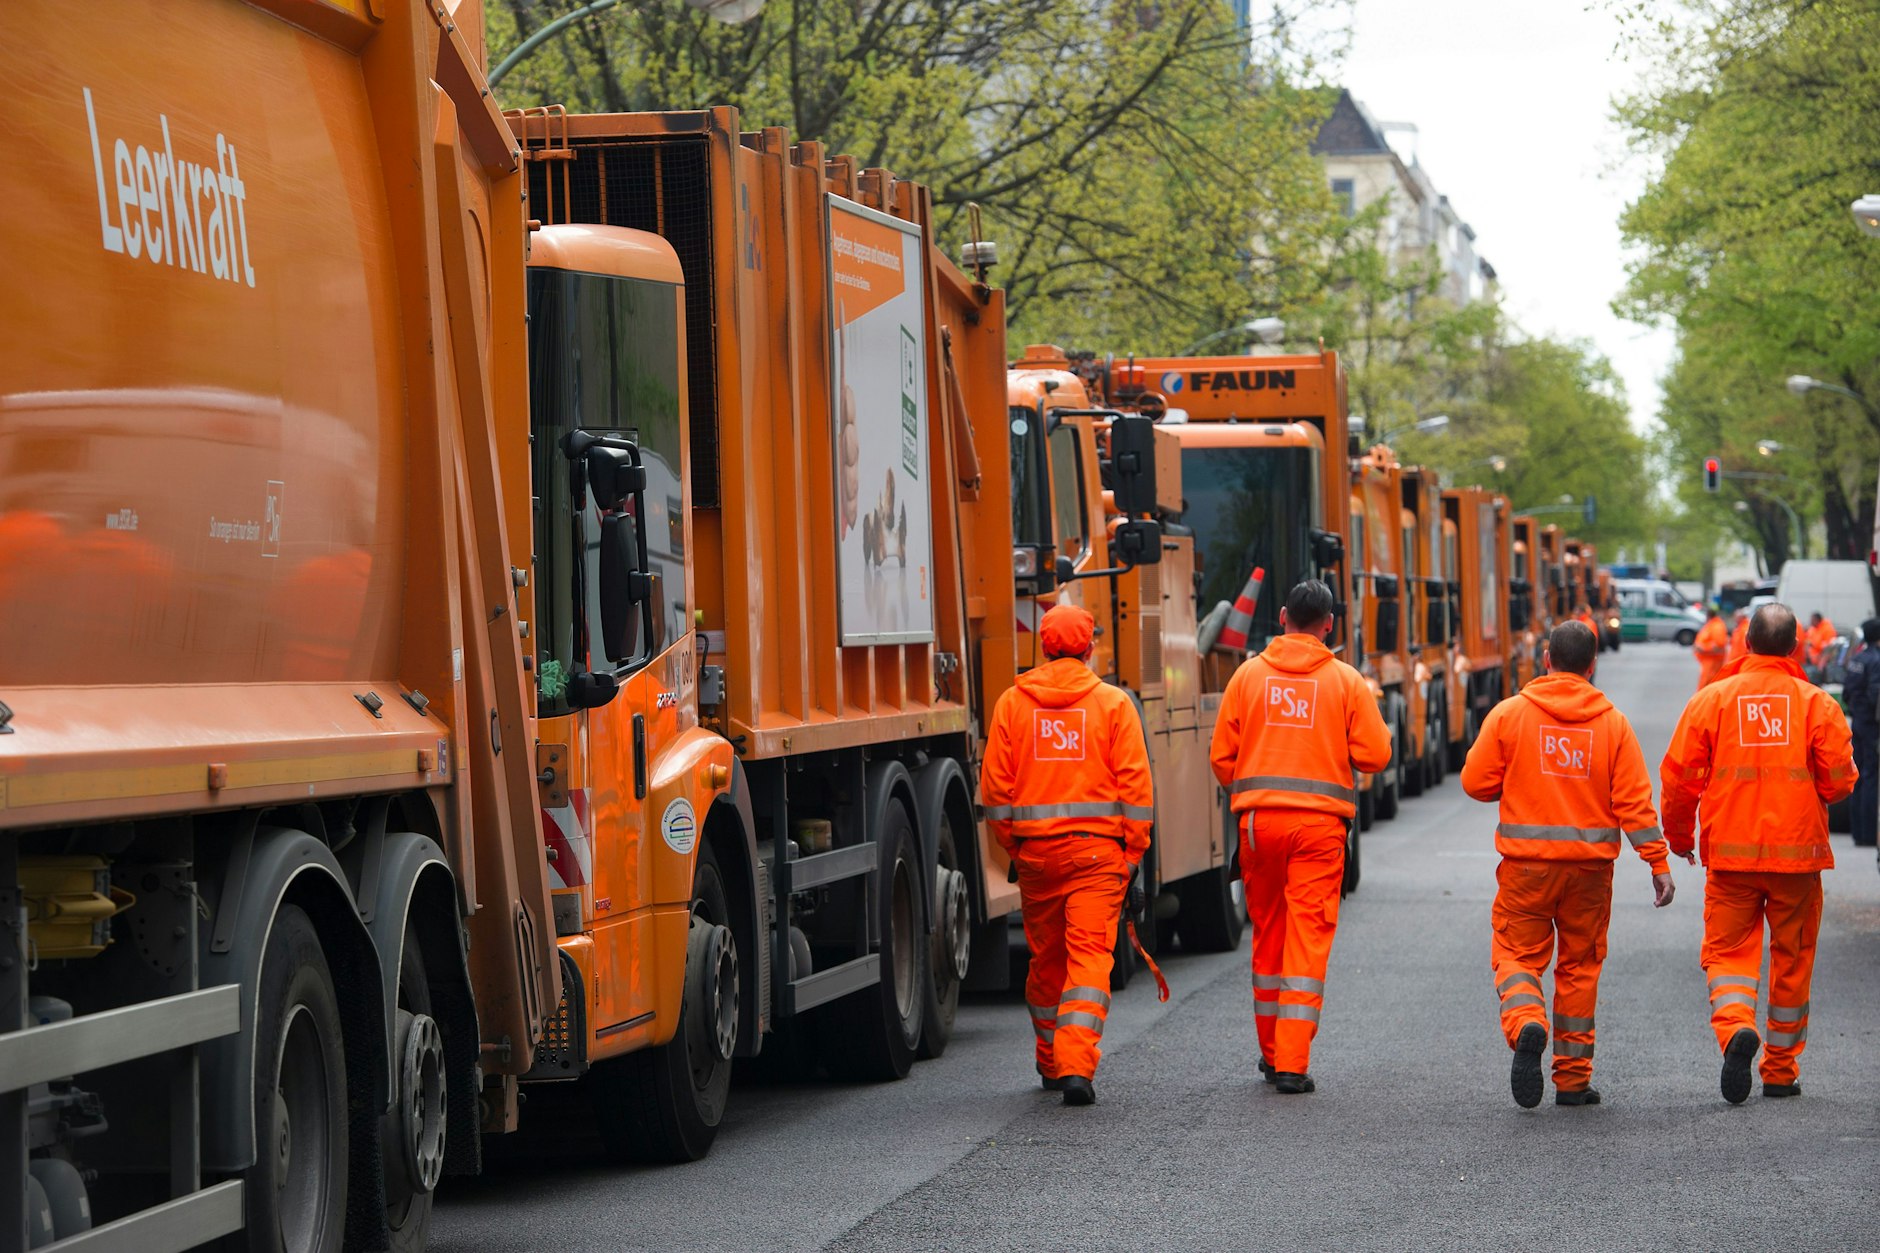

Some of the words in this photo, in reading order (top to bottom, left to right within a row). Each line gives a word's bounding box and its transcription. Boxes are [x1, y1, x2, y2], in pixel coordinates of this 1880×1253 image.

[83, 87, 255, 288] Leerkraft
[1190, 369, 1295, 392] FAUN
[1270, 686, 1309, 719] BSR
[1040, 718, 1080, 751] BSR
[1746, 702, 1784, 738] BSR
[1545, 735, 1584, 769] BSR
